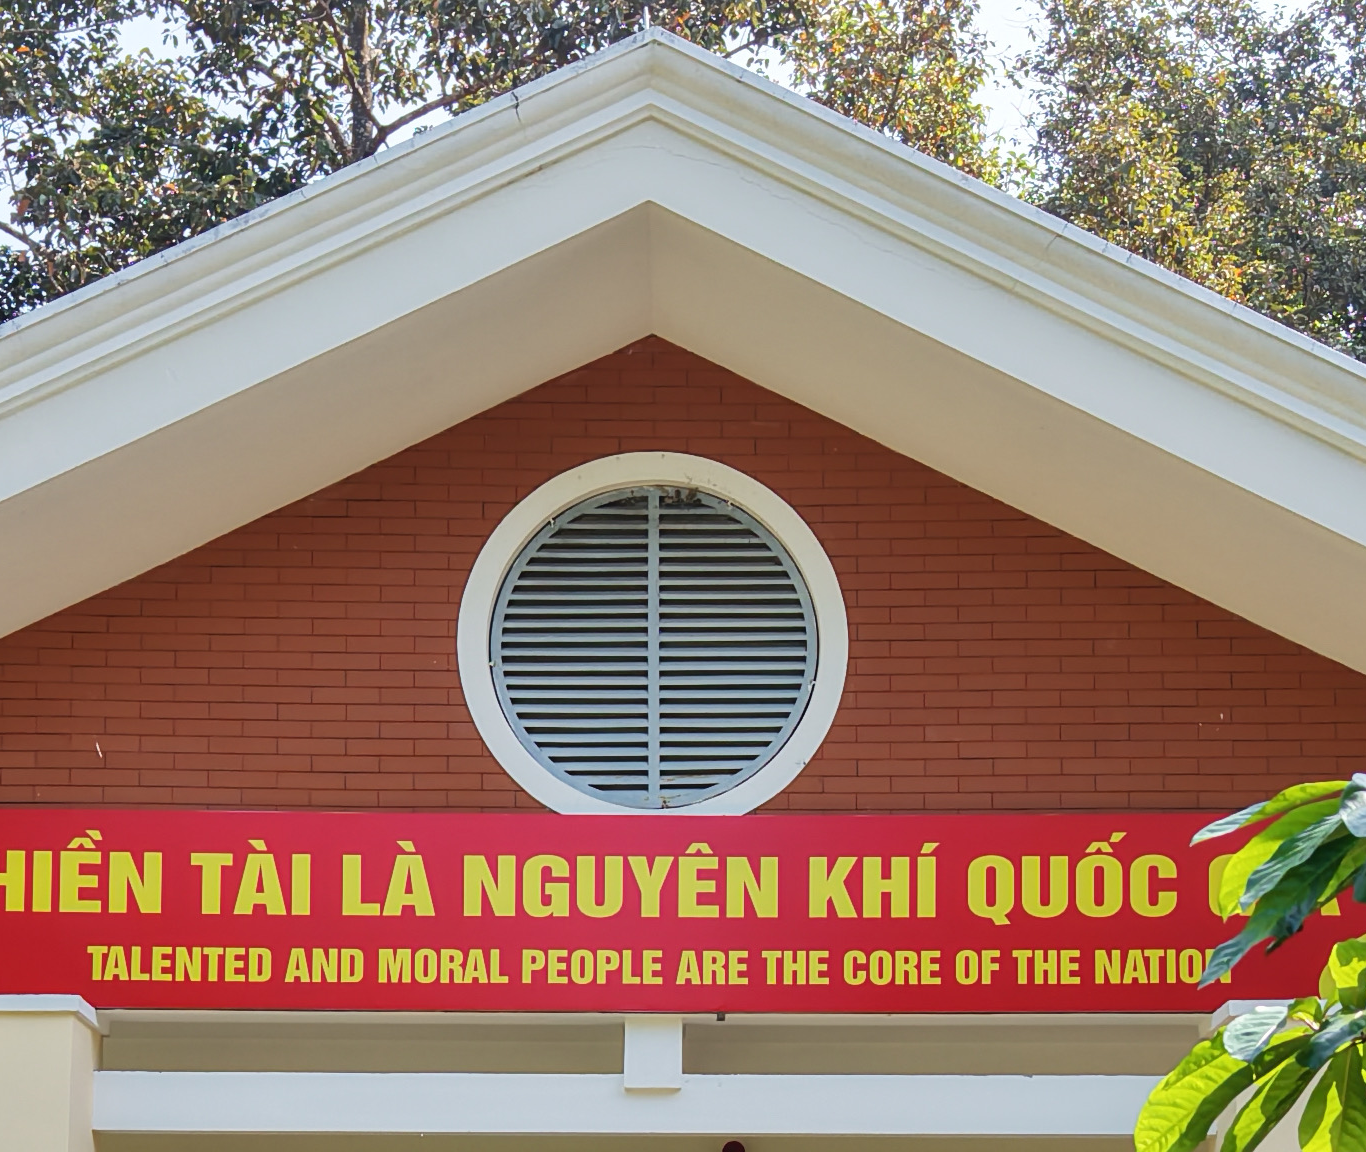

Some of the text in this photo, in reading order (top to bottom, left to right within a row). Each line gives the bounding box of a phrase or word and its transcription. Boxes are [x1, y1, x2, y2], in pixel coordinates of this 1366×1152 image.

[190, 839, 312, 916] TÀI
[341, 840, 436, 917] LÀ
[463, 842, 779, 919] NGUYÊN
[808, 842, 940, 919] KHÍ
[967, 831, 1178, 926] QUỐC
[86, 945, 272, 983] TALENTED
[284, 947, 364, 983] AND
[377, 948, 509, 984] MORAL
[521, 948, 663, 985] PEOPLE
[675, 950, 749, 985] ARE
[761, 950, 830, 985] THE
[843, 949, 942, 986] CORE
[955, 949, 1001, 985] OF
[1011, 949, 1081, 985] THE
